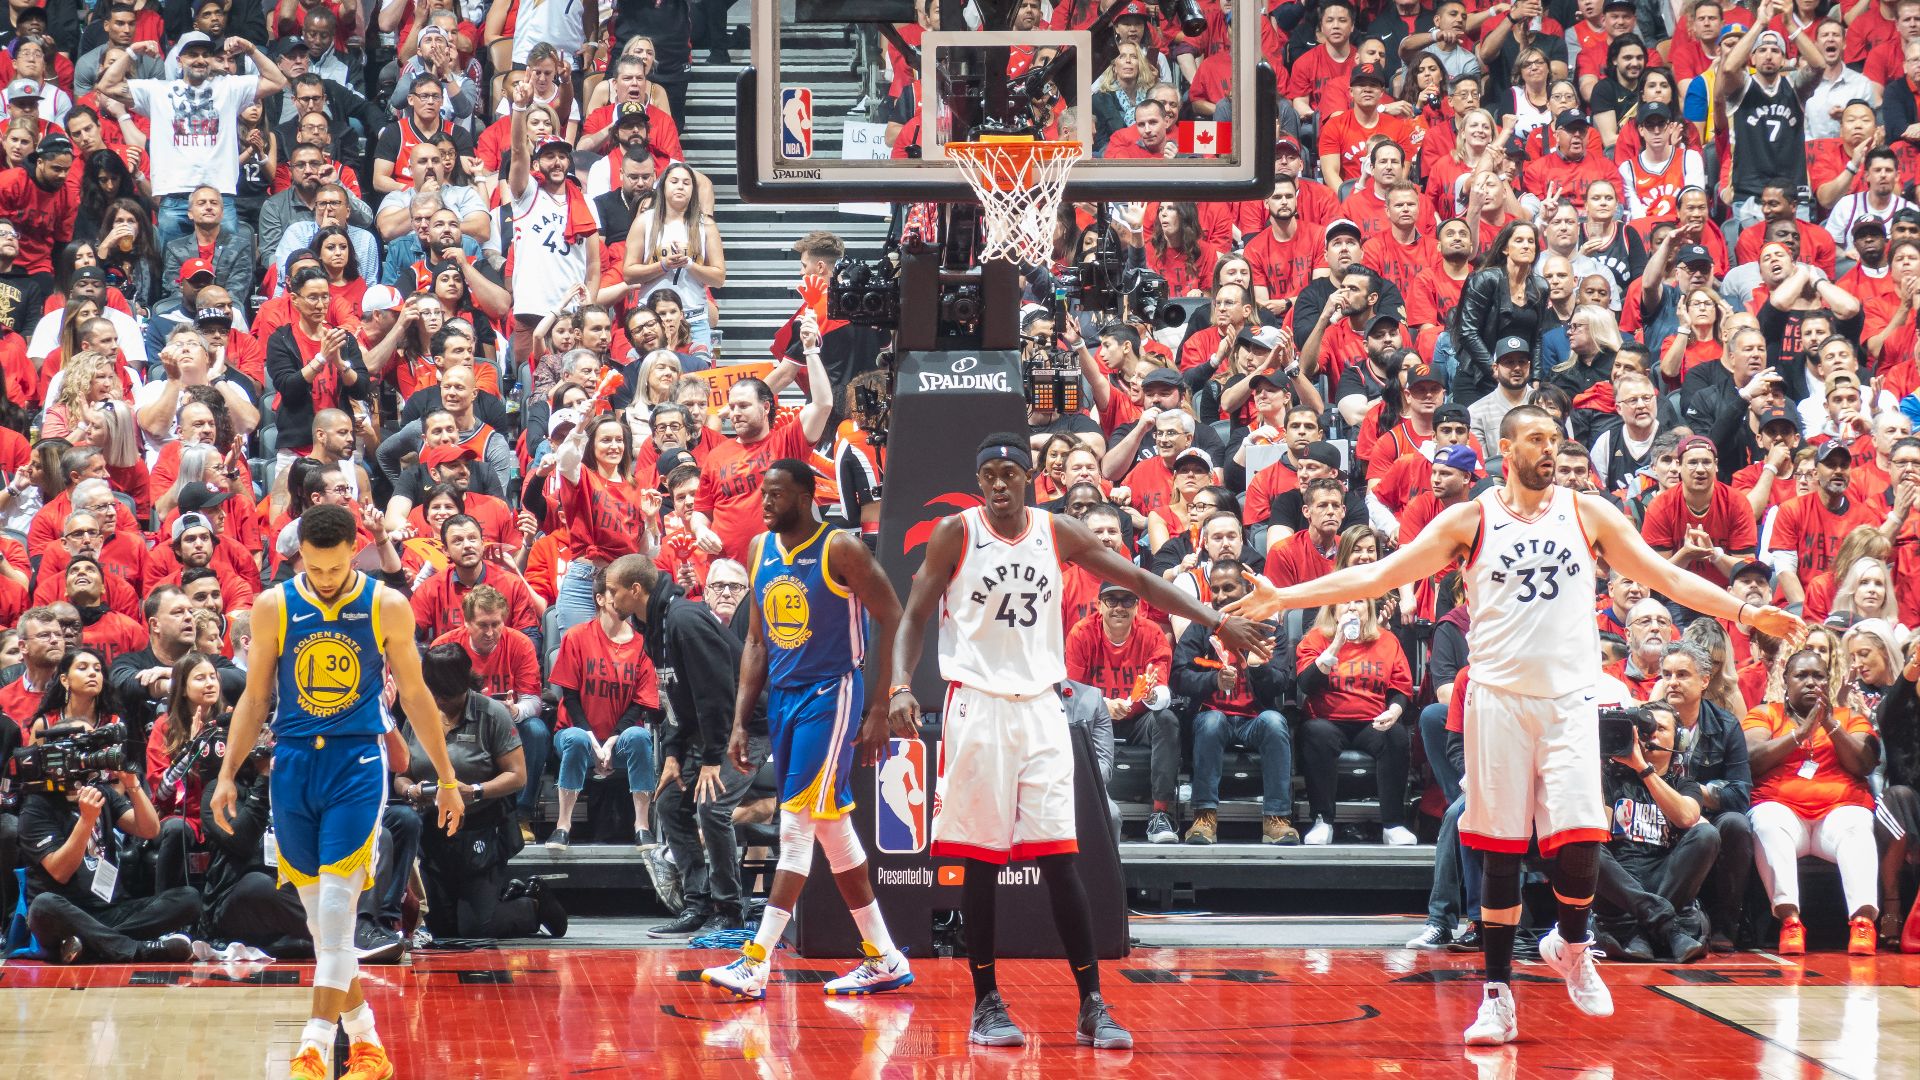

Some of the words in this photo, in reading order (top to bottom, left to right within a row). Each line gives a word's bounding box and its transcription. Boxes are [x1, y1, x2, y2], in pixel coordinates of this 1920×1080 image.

[1746, 103, 1799, 128] RAPTORS
[173, 134, 217, 147] NORTH
[852, 128, 868, 144] US
[1764, 119, 1781, 143] 7
[785, 142, 801, 155] NBA
[243, 163, 260, 182] 12
[773, 169, 821, 181] SPALDING
[1361, 218, 1381, 232] WE
[651, 248, 699, 264] NOTH
[1287, 254, 1313, 272] THE
[1592, 255, 1631, 282] TORS
[719, 462, 737, 481] WE
[591, 489, 610, 506] WE
[1142, 493, 1162, 509] WE
[1804, 532, 1825, 551] WE
[1491, 540, 1581, 584] RAPTORS
[761, 574, 788, 595] GOLDEN
[789, 575, 809, 597] STATE
[971, 563, 1053, 606] RAPTORS
[1515, 566, 1560, 604] 33
[785, 594, 802, 610] 23
[994, 592, 1038, 628] 43
[342, 612, 369, 621] Rakuten
[441, 607, 462, 626] WE
[294, 631, 331, 654] GOLDEN
[333, 631, 363, 654] STATE
[767, 627, 813, 650] WARRIORS
[326, 654, 351, 673] 30
[586, 655, 604, 677] WE
[1347, 660, 1384, 677] THE
[296, 691, 361, 718] WARRIORS
[1633, 803, 1657, 825] NBA
[878, 867, 921, 885] Presented
[923, 867, 934, 888] by
